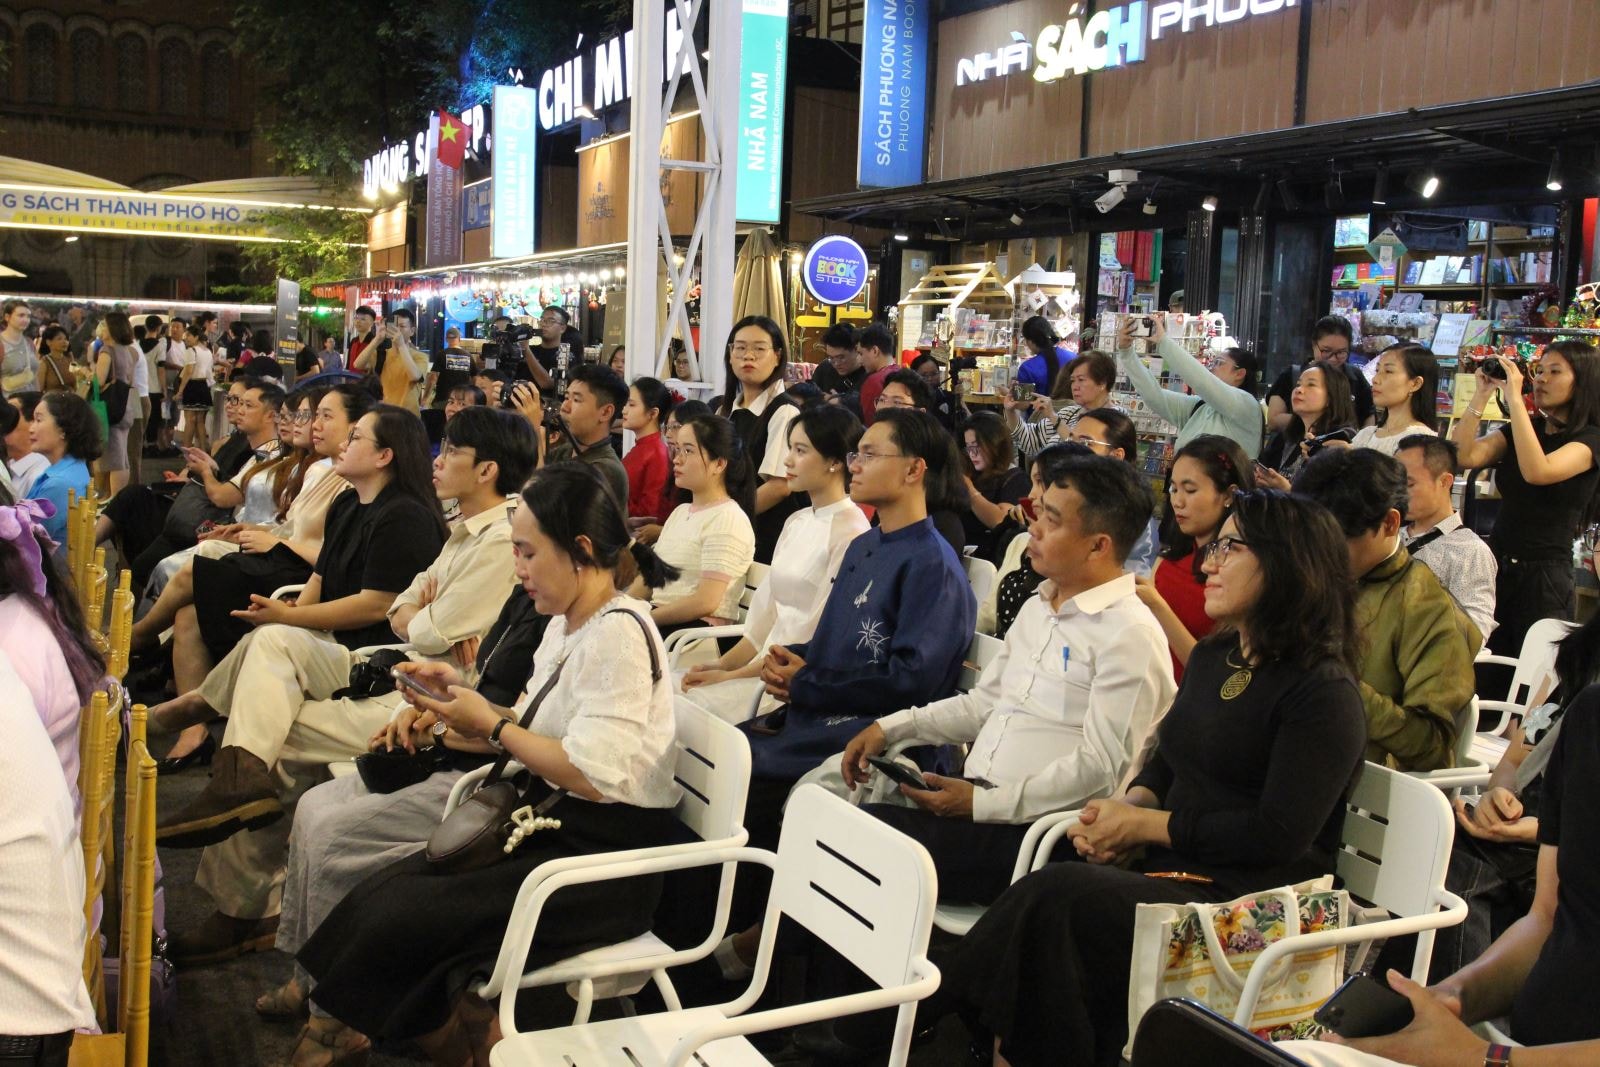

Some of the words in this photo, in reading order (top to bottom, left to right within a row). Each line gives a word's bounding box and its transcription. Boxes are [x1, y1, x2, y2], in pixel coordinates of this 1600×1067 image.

[903, 0, 915, 38] BOO
[879, 25, 896, 107] PHƯƠNG
[902, 44, 913, 80] NAM
[956, 31, 1033, 86] NHÀ
[1033, 2, 1147, 84] SÁCH
[539, 33, 583, 130] CHÍ
[748, 72, 768, 119] NAM
[874, 110, 893, 166] SÁCH
[899, 86, 911, 152] PHUONG
[744, 127, 767, 171] NHÃ
[23, 191, 79, 212] SÁCH
[86, 196, 157, 217] THÀNH
[163, 202, 206, 220] PHỐ
[211, 204, 241, 222] HỒ
[815, 273, 857, 287] STORE
[817, 259, 858, 279] BOOK
